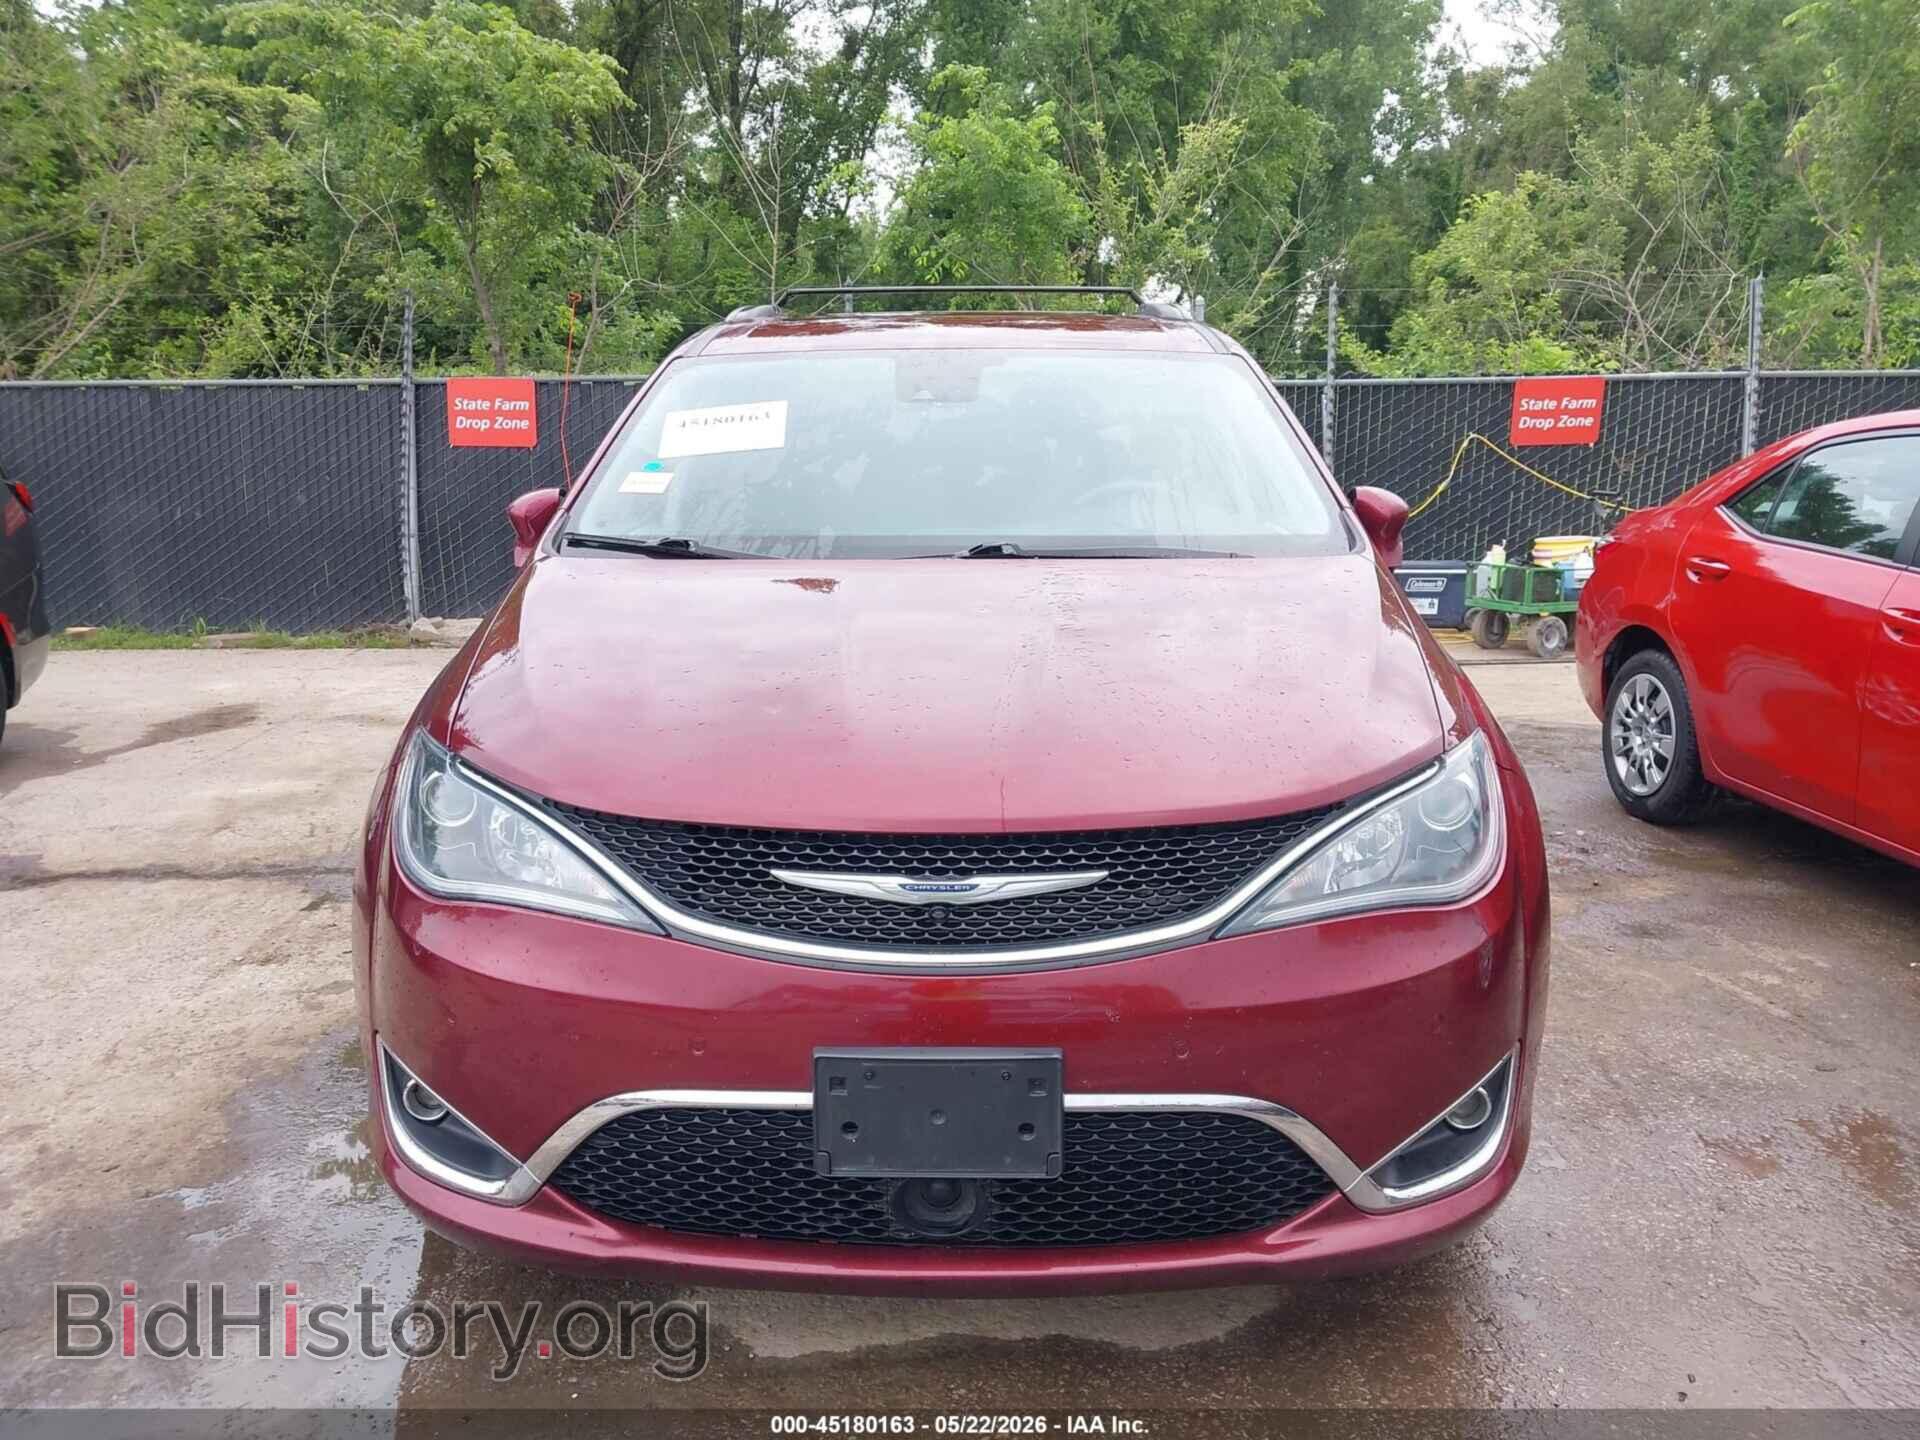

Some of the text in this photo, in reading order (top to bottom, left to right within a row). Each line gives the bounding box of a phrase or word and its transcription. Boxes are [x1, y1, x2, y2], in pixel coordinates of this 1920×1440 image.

[454, 397, 530, 411] State Farm
[1519, 397, 1597, 411] State Farm
[455, 415, 529, 432] Drop Zone
[1518, 415, 1594, 431] Drop Zone
